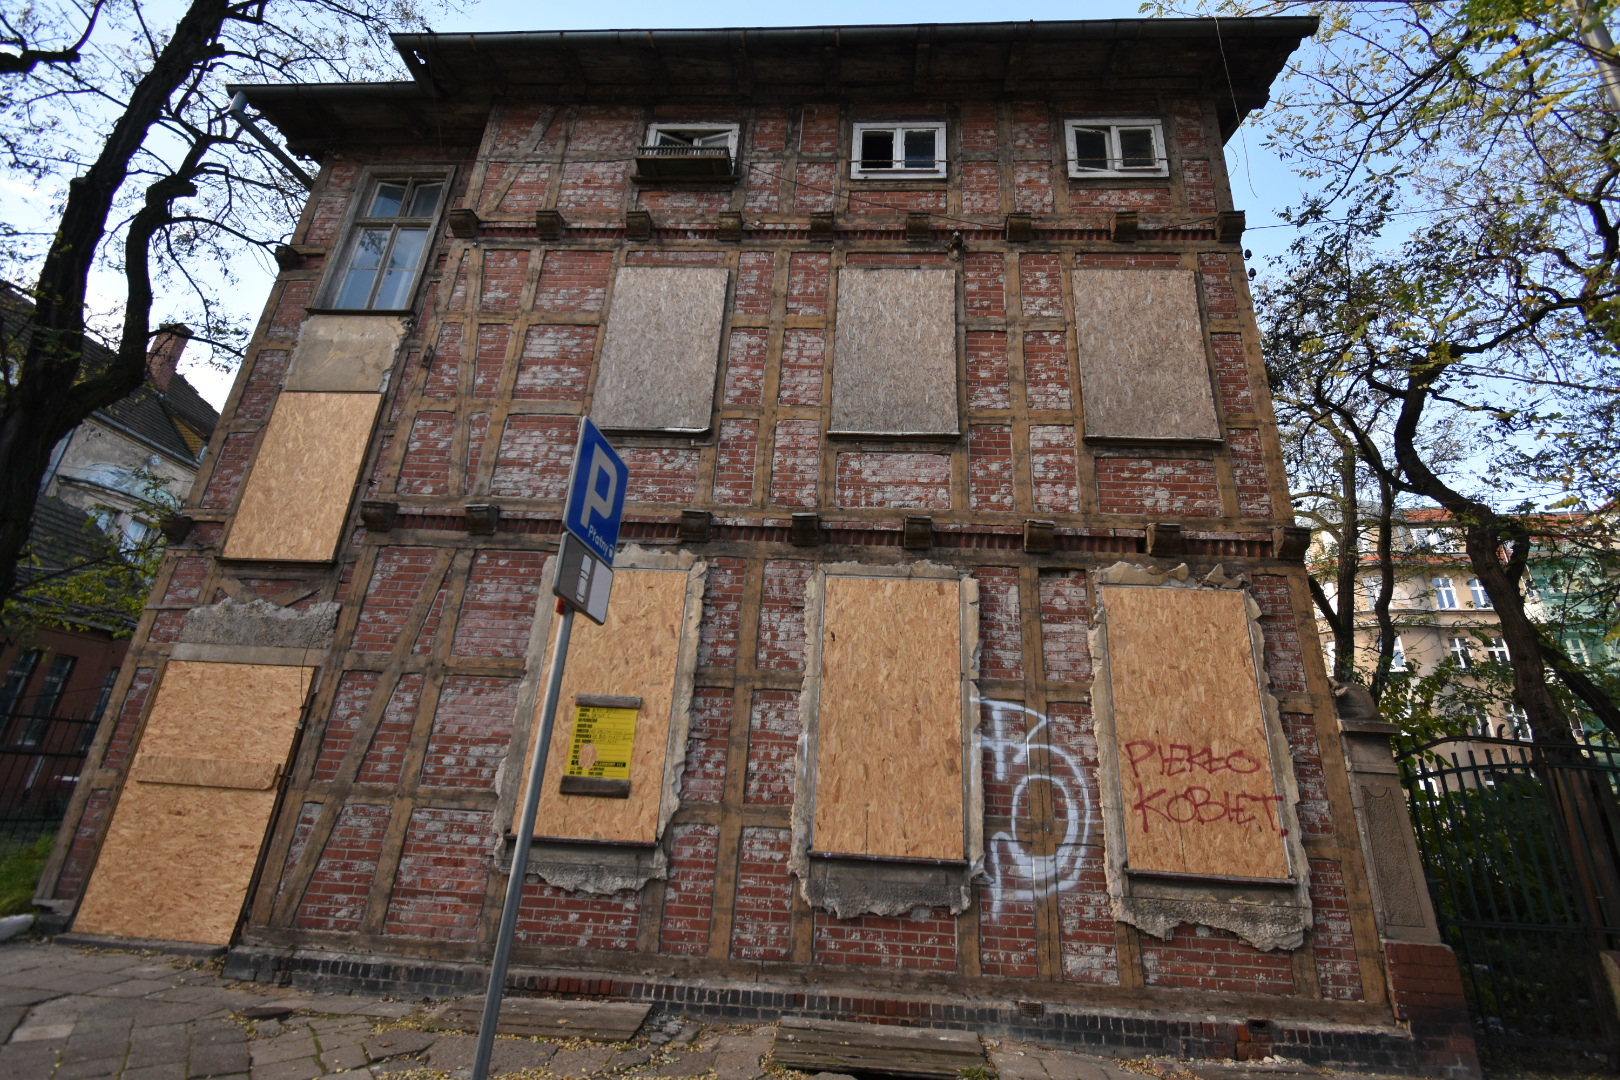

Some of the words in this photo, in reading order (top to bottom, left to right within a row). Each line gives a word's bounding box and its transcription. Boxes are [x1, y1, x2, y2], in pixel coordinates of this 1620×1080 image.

[580, 442, 618, 529] P
[588, 524, 609, 556] Płatny
[1125, 740, 1261, 778] PIEKŁO
